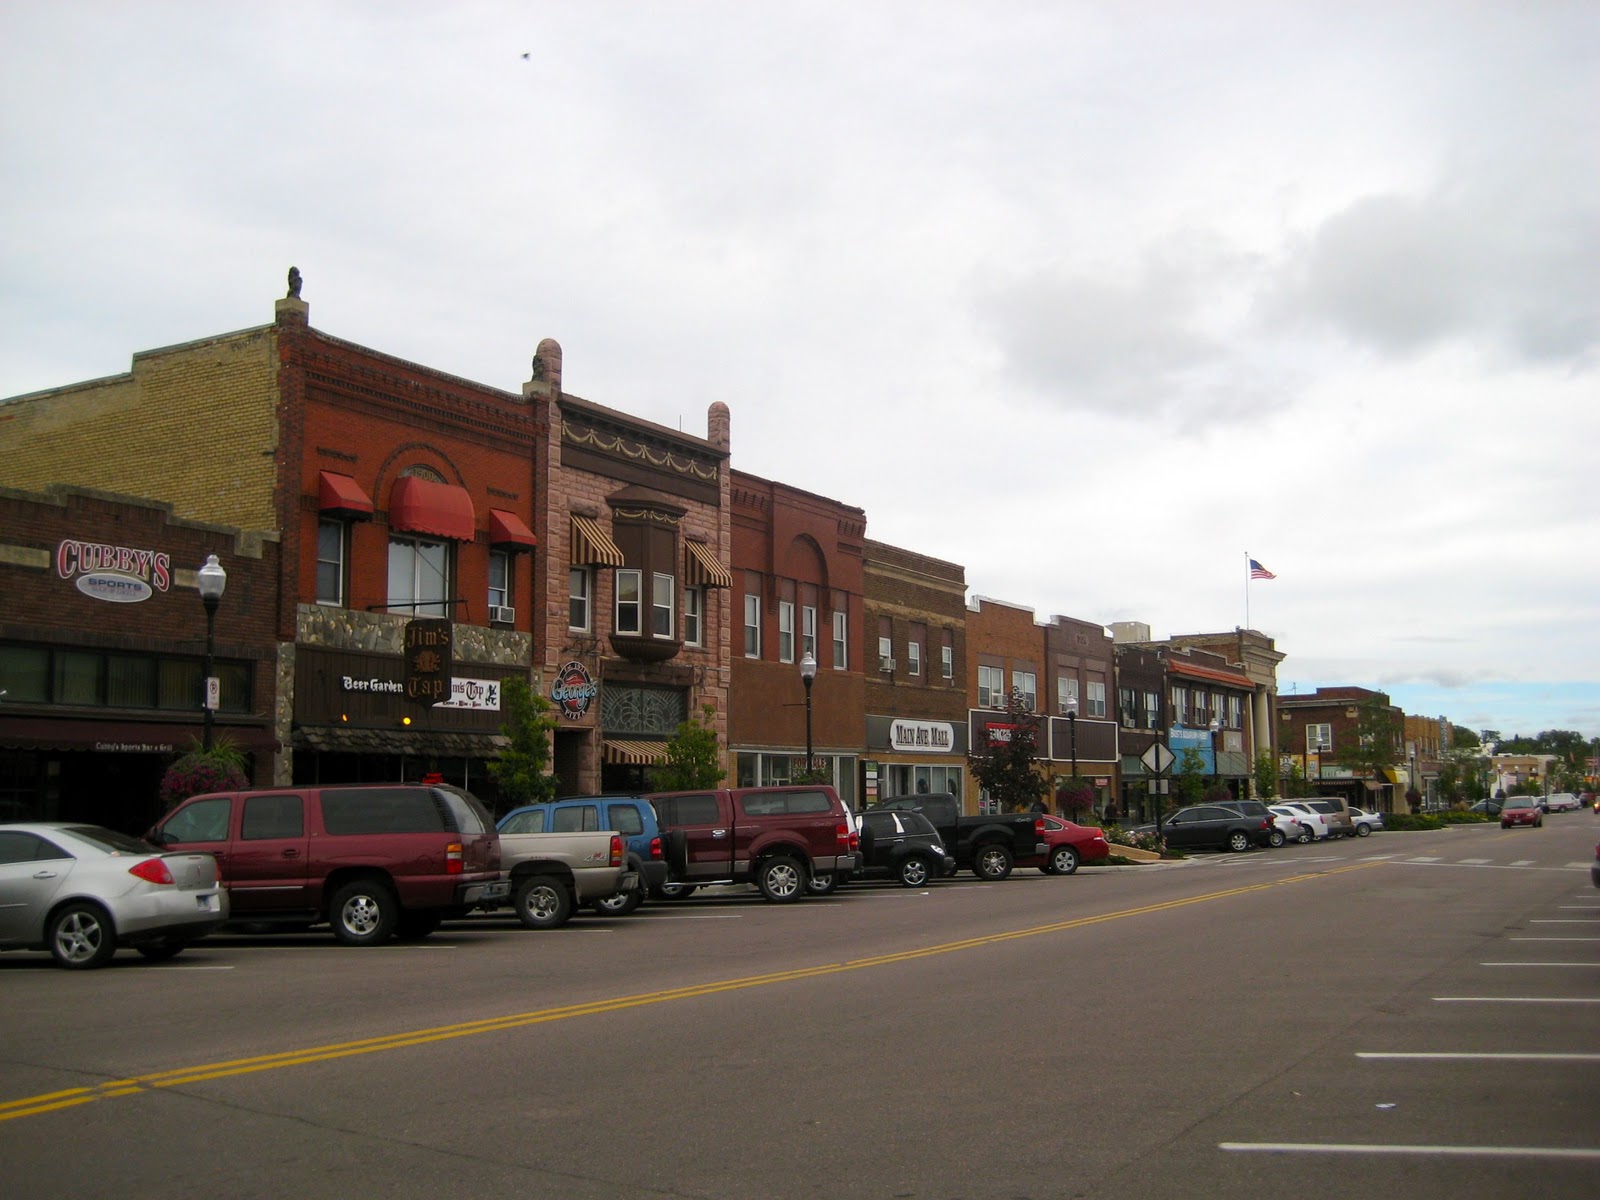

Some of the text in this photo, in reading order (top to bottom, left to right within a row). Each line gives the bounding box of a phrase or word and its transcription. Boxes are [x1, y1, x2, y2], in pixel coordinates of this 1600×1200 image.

[58, 539, 170, 592] CUBBY'S
[88, 578, 142, 591] SPORTS
[407, 625, 449, 648] Jim's
[343, 676, 404, 693] Beer Garden
[408, 676, 444, 699] Tap
[452, 681, 484, 701] m's Tap
[551, 677, 597, 709] George's
[564, 709, 586, 720] PIZZA
